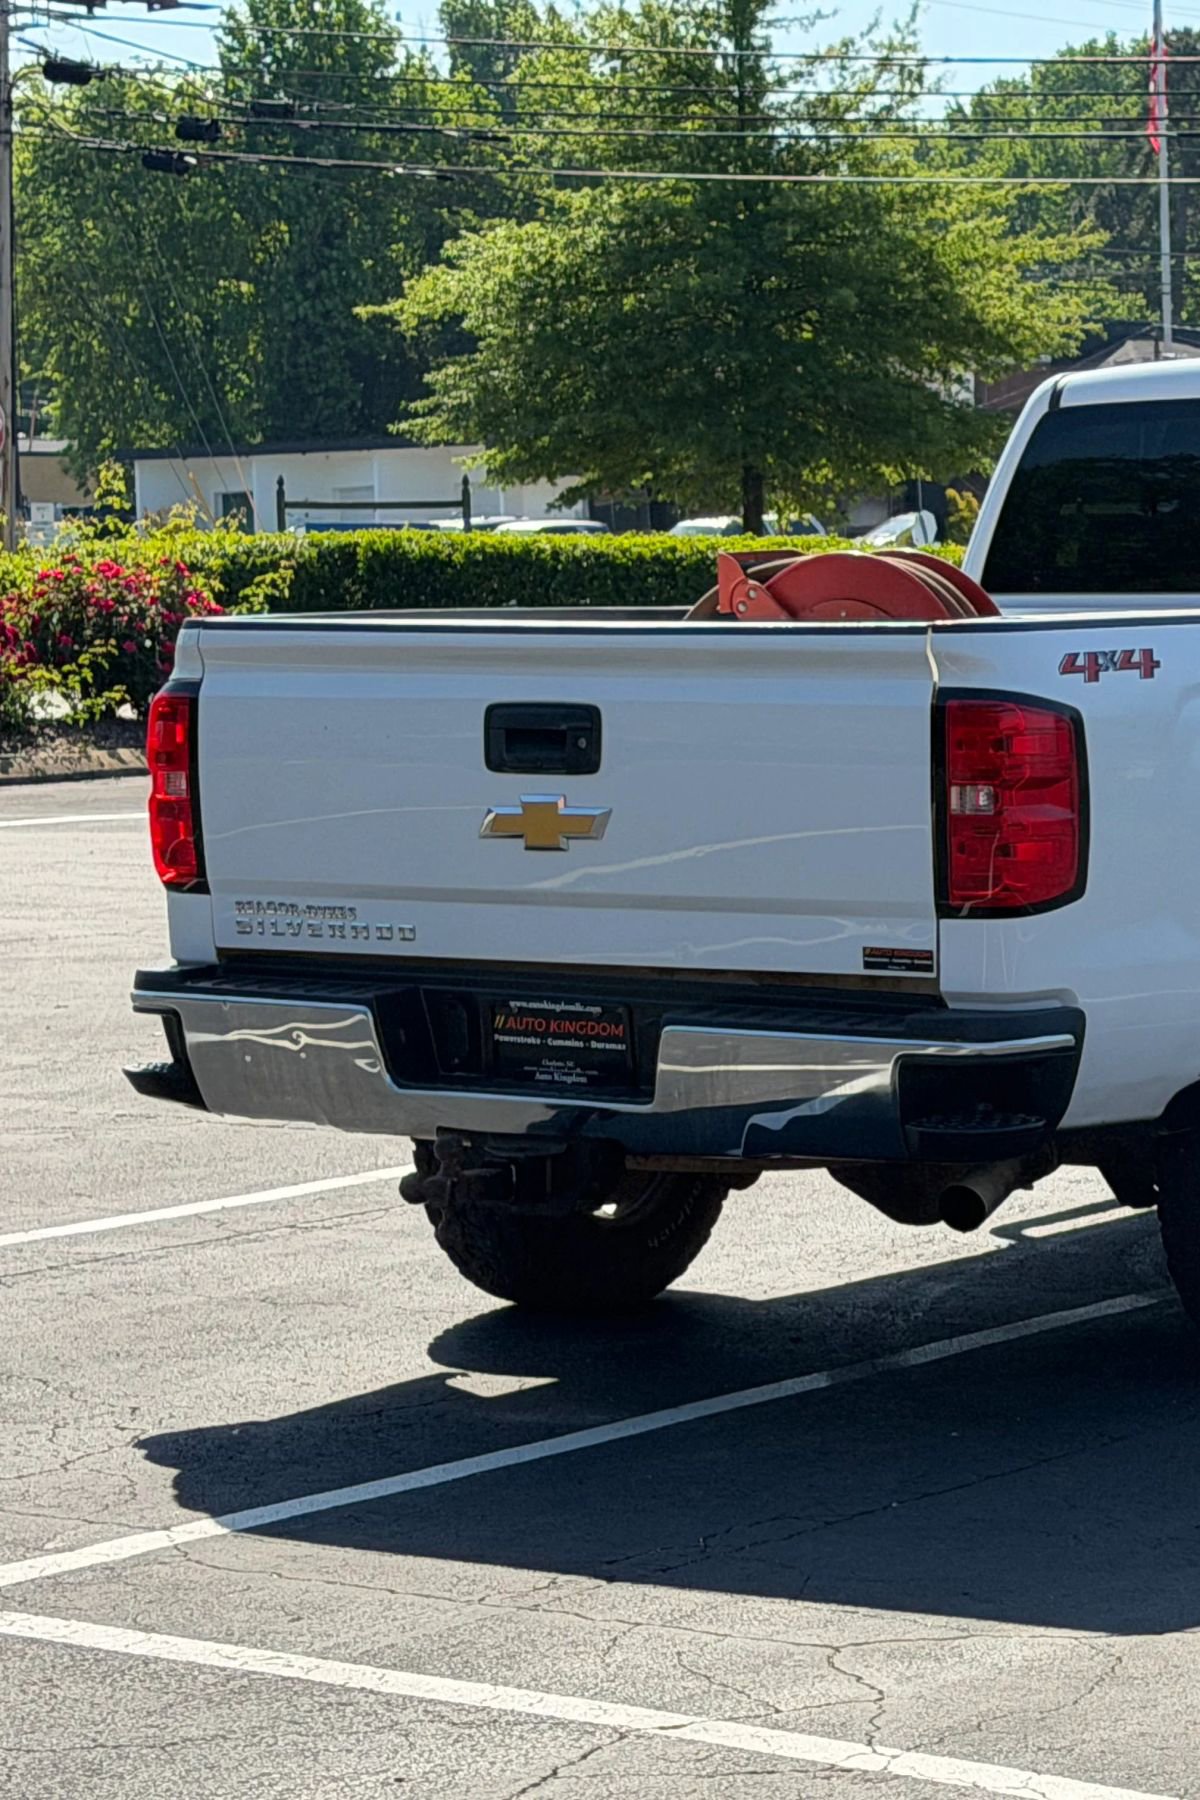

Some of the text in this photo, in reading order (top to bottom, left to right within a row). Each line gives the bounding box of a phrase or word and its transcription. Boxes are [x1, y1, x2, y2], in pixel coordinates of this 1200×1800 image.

[236, 918, 417, 941] SILVERADO
[550, 1019, 624, 1037] KINGDOM
[494, 1034, 626, 1051] Powerstroke Cummins Duramax
